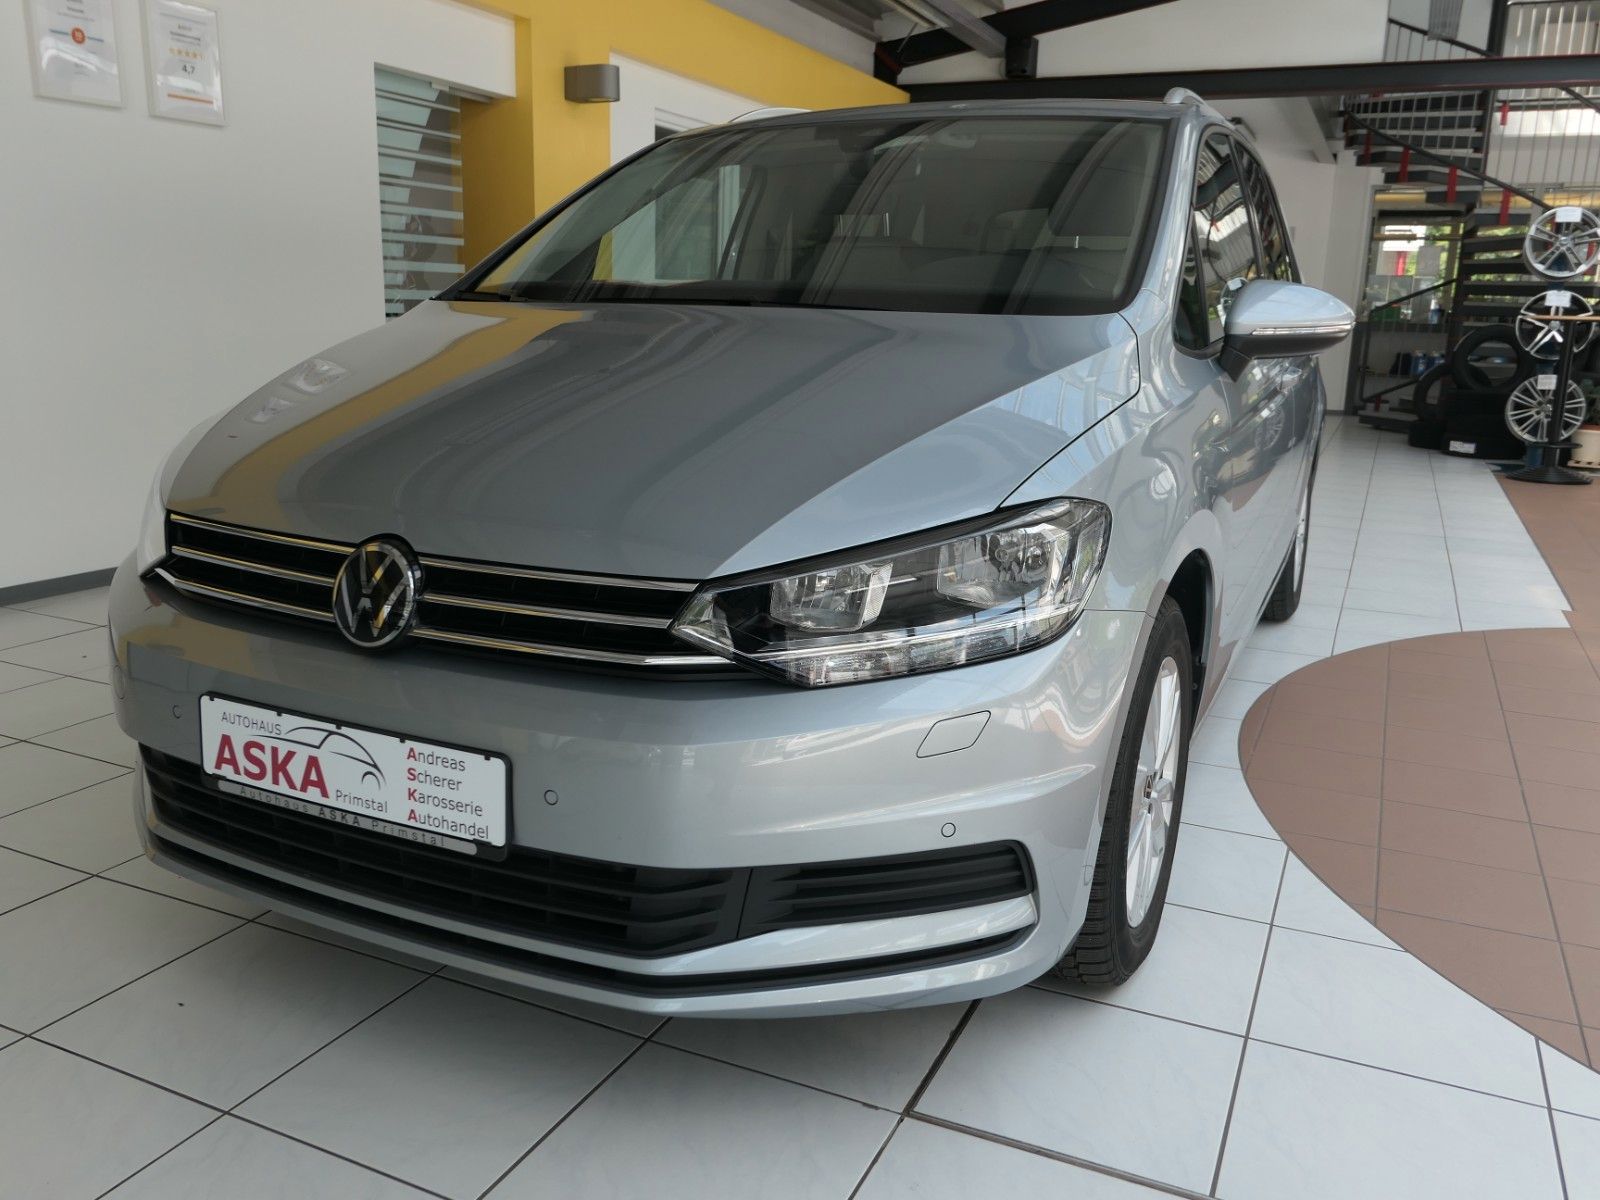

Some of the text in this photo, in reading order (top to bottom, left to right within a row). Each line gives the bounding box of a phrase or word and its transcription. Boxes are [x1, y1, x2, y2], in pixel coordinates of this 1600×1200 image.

[221, 711, 282, 736] AUTOHAUS
[214, 733, 330, 799] ASKA
[406, 747, 466, 772] Andreas
[407, 767, 463, 792] Scherer
[335, 789, 388, 813] Primstal
[408, 787, 483, 817] Karosserie
[240, 786, 446, 847] Autohaus ASKA Primstal
[408, 809, 489, 839] Autohandel
